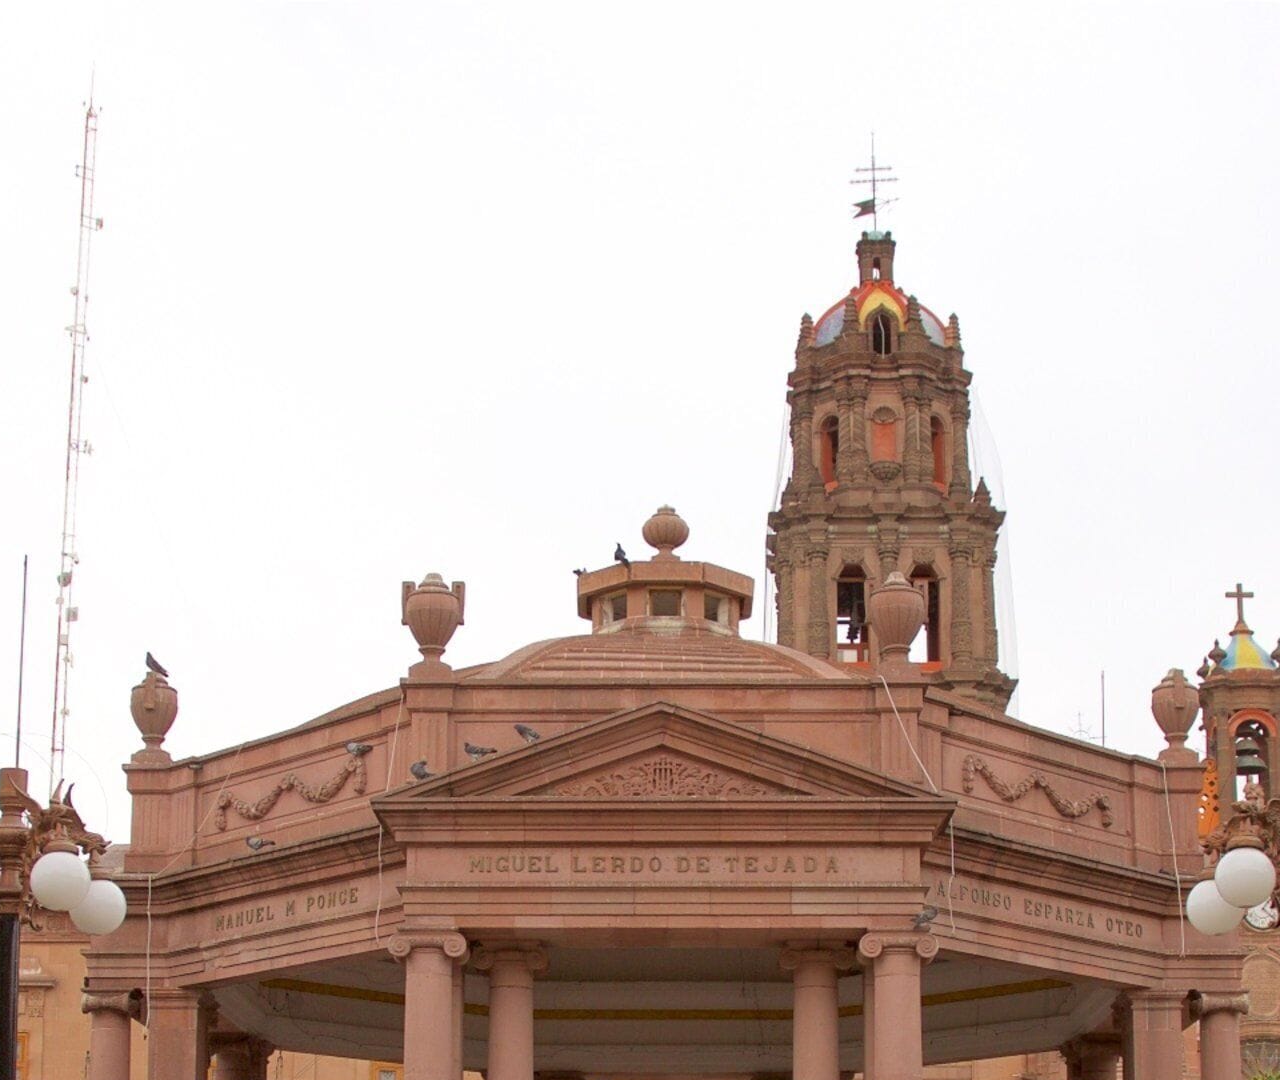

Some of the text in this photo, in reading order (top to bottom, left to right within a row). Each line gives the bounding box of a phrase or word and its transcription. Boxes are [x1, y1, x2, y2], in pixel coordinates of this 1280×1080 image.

[469, 856, 839, 873] MIGUEL LERDO DE TEJADA
[215, 887, 359, 932] MANUEL M PONCE
[936, 880, 1143, 938] ALFONSO ESPARZA OTEO
